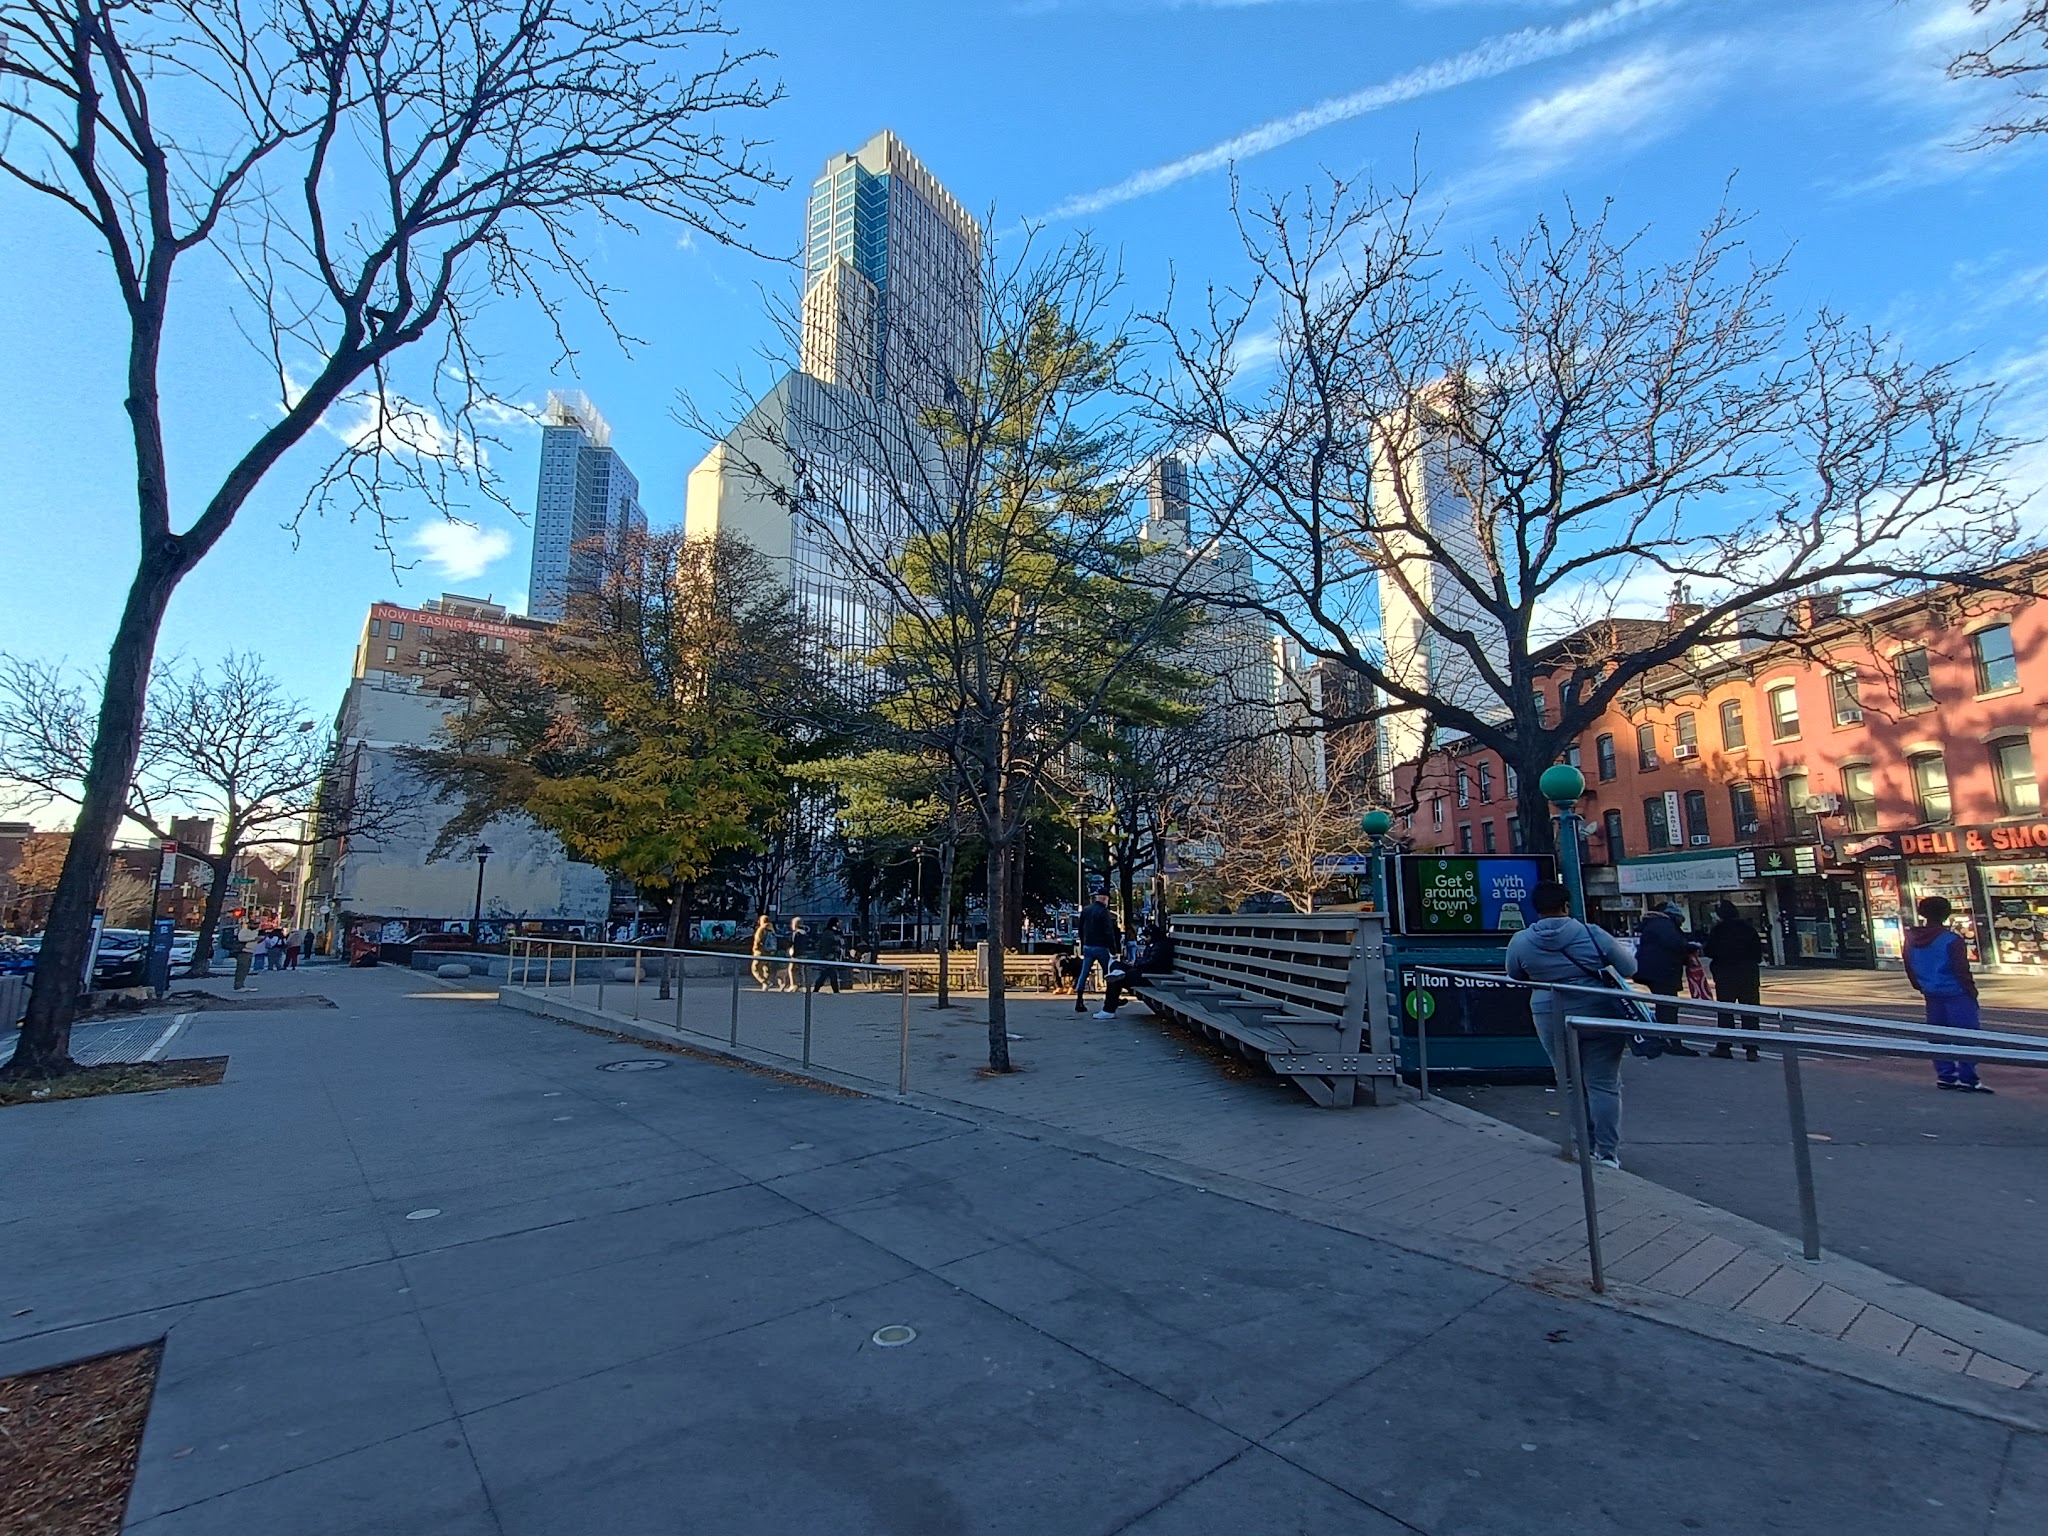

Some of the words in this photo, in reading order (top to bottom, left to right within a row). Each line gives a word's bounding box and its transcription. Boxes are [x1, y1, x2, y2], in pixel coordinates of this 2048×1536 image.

[378, 608, 409, 620] NOW
[412, 613, 462, 629] LEASING
[1667, 794, 1679, 838] THREADING
[1901, 832, 1959, 854] DELI
[1966, 830, 1986, 851] &
[1993, 824, 2048, 849] SMO
[1435, 875, 1462, 888] Get
[1493, 875, 1524, 888] with
[1424, 885, 1474, 898] around
[1493, 888, 1501, 899] a
[1504, 887, 1527, 902] tap
[1432, 898, 1468, 911] town
